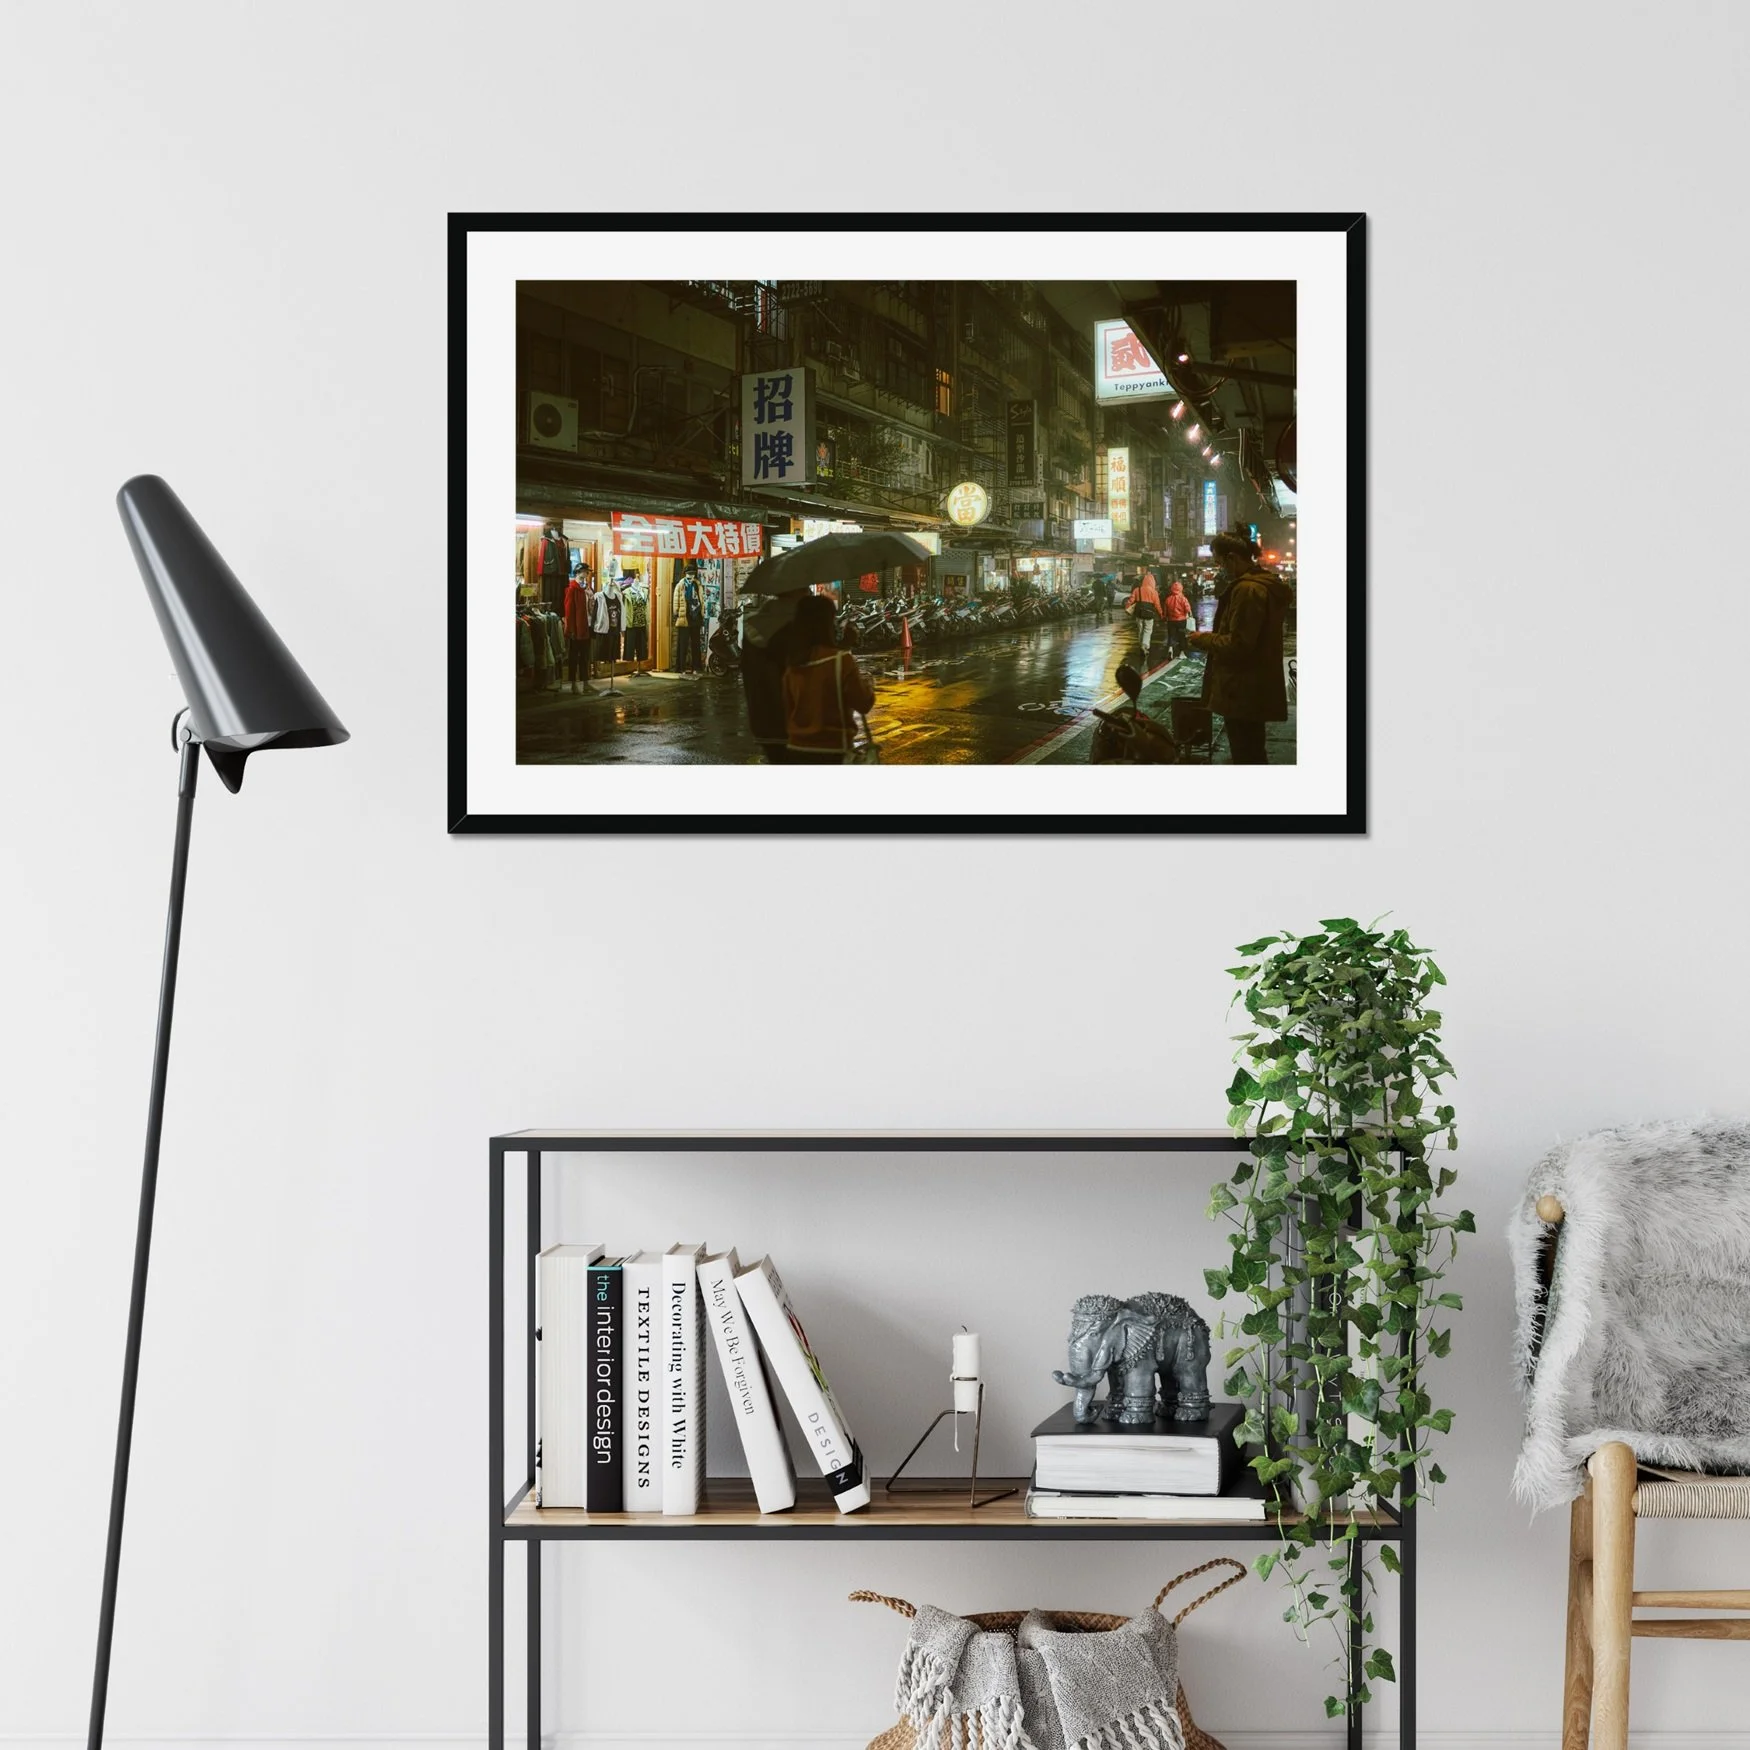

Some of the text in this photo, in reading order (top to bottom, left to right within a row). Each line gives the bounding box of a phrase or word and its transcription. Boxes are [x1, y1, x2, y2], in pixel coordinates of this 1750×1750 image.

[753, 373, 794, 480] 招牌
[1111, 456, 1127, 493] 福順
[619, 514, 760, 555] 全面大特價
[953, 485, 982, 523] 當
[593, 1275, 616, 1464] the interior design
[637, 1287, 650, 1489] TEXTILE DESIGNS
[668, 1282, 687, 1469] Decorating with White
[711, 1279, 754, 1415] May We Be Forgiven
[807, 1411, 849, 1485] DESIGN
